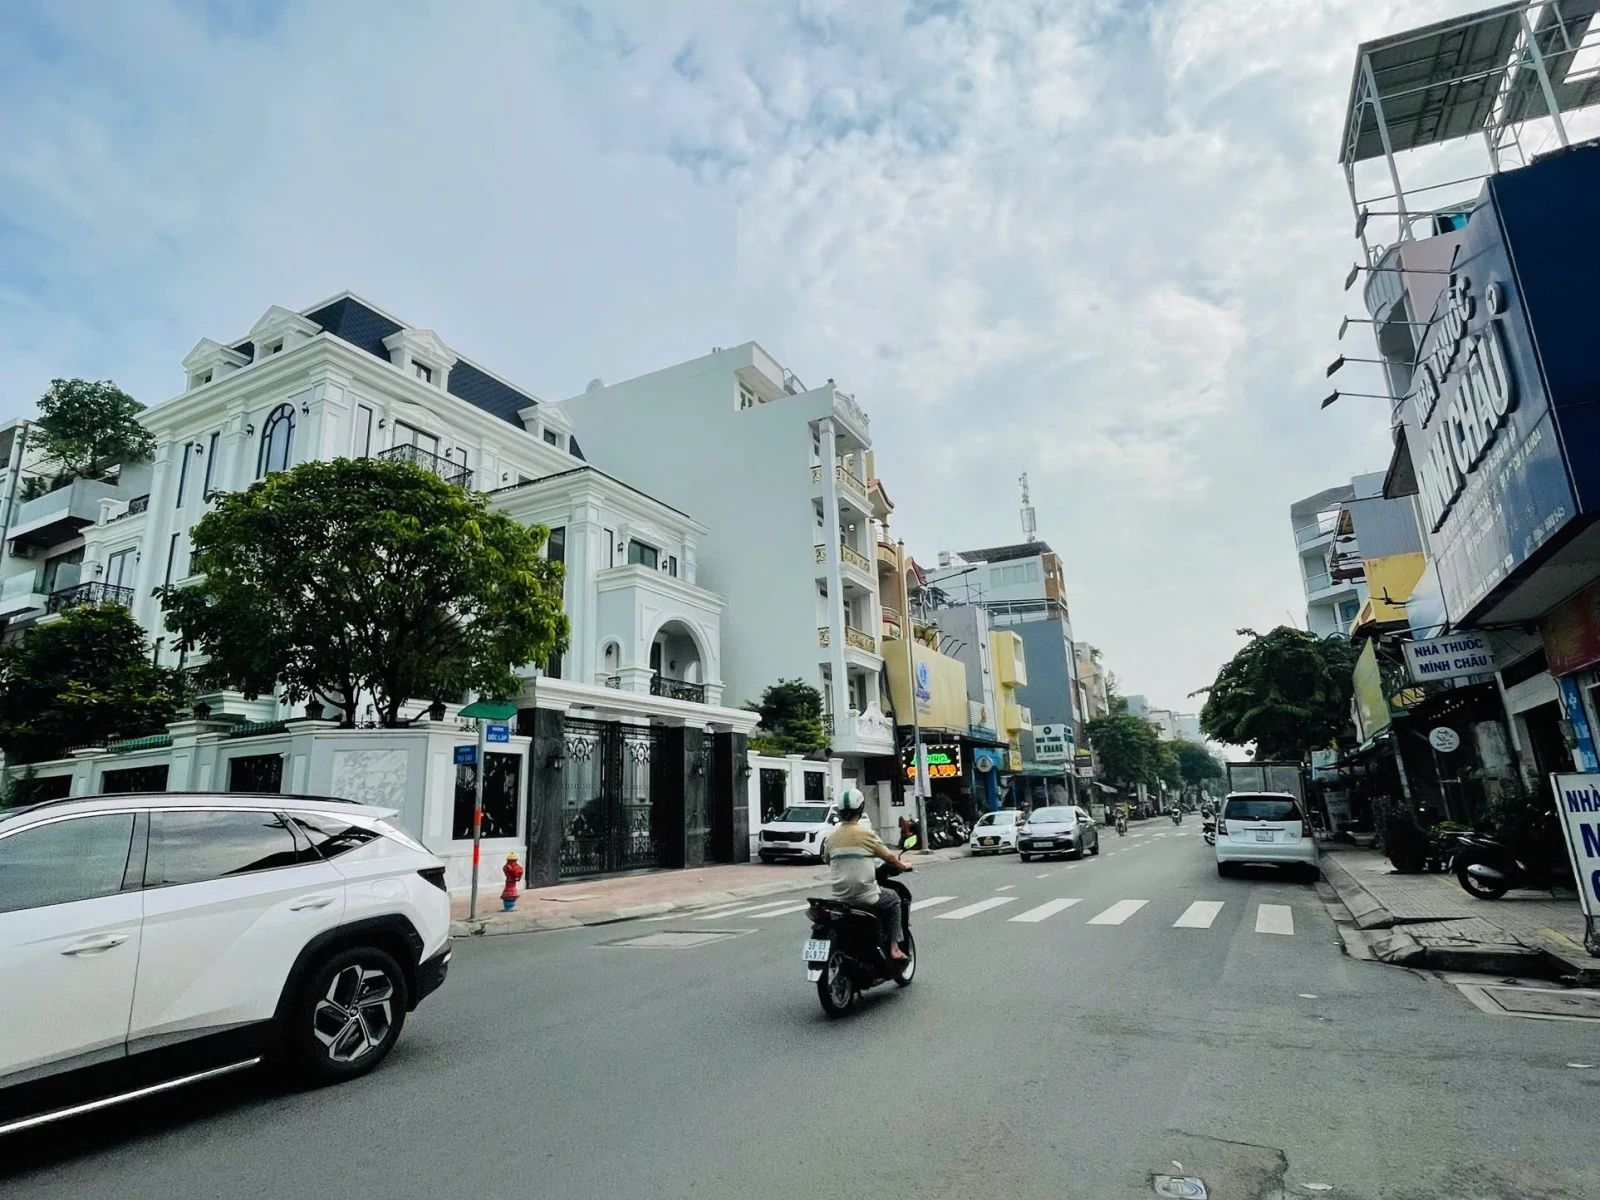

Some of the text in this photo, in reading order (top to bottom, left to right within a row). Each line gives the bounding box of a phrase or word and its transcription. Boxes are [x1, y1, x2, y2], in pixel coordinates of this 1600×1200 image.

[1418, 420, 1460, 533] MINH
[1448, 320, 1509, 475] CHÂU
[1414, 634, 1484, 658] NHÀ THUỐC
[1454, 653, 1487, 668] CHÂU
